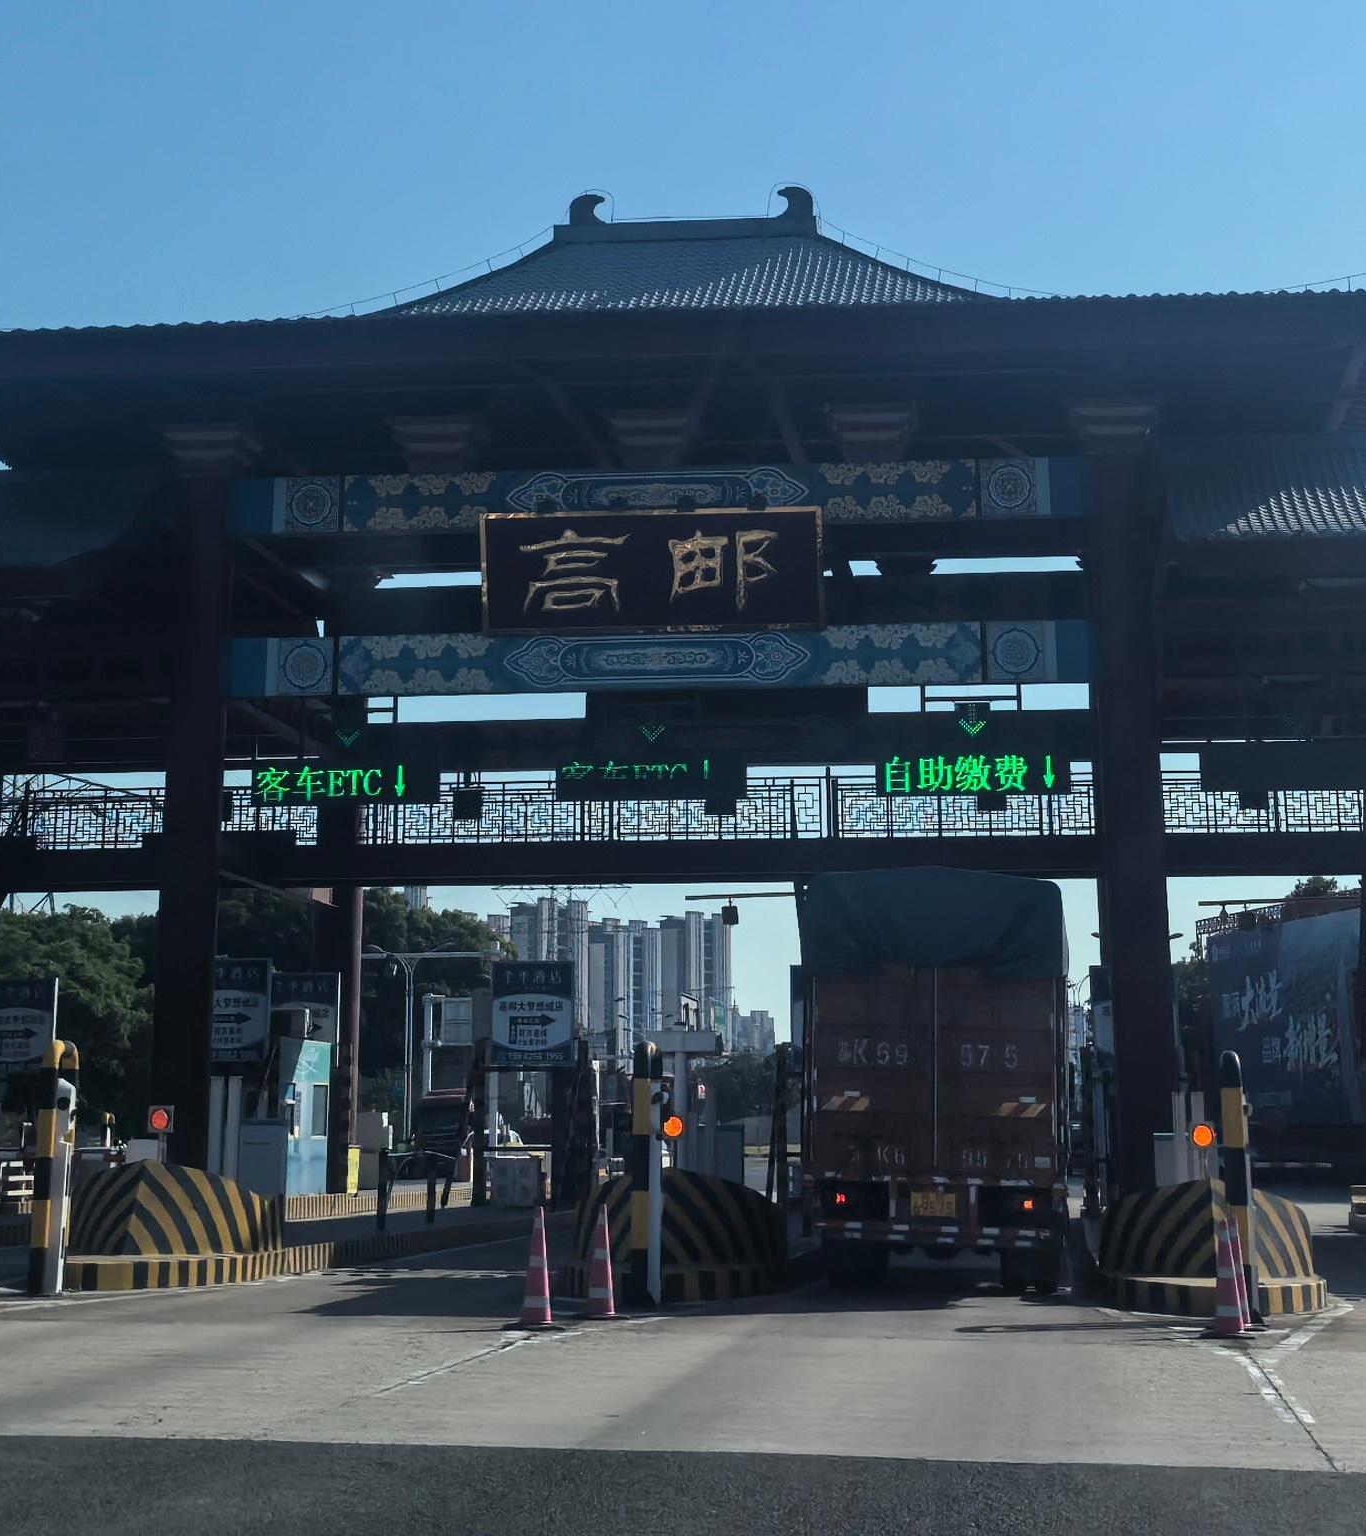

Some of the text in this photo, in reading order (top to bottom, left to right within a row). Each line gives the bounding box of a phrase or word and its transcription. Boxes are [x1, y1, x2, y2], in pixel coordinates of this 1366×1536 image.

[519, 528, 779, 614] 高邮
[255, 764, 384, 804] 客车ETC
[882, 754, 1031, 794] 自助缴费
